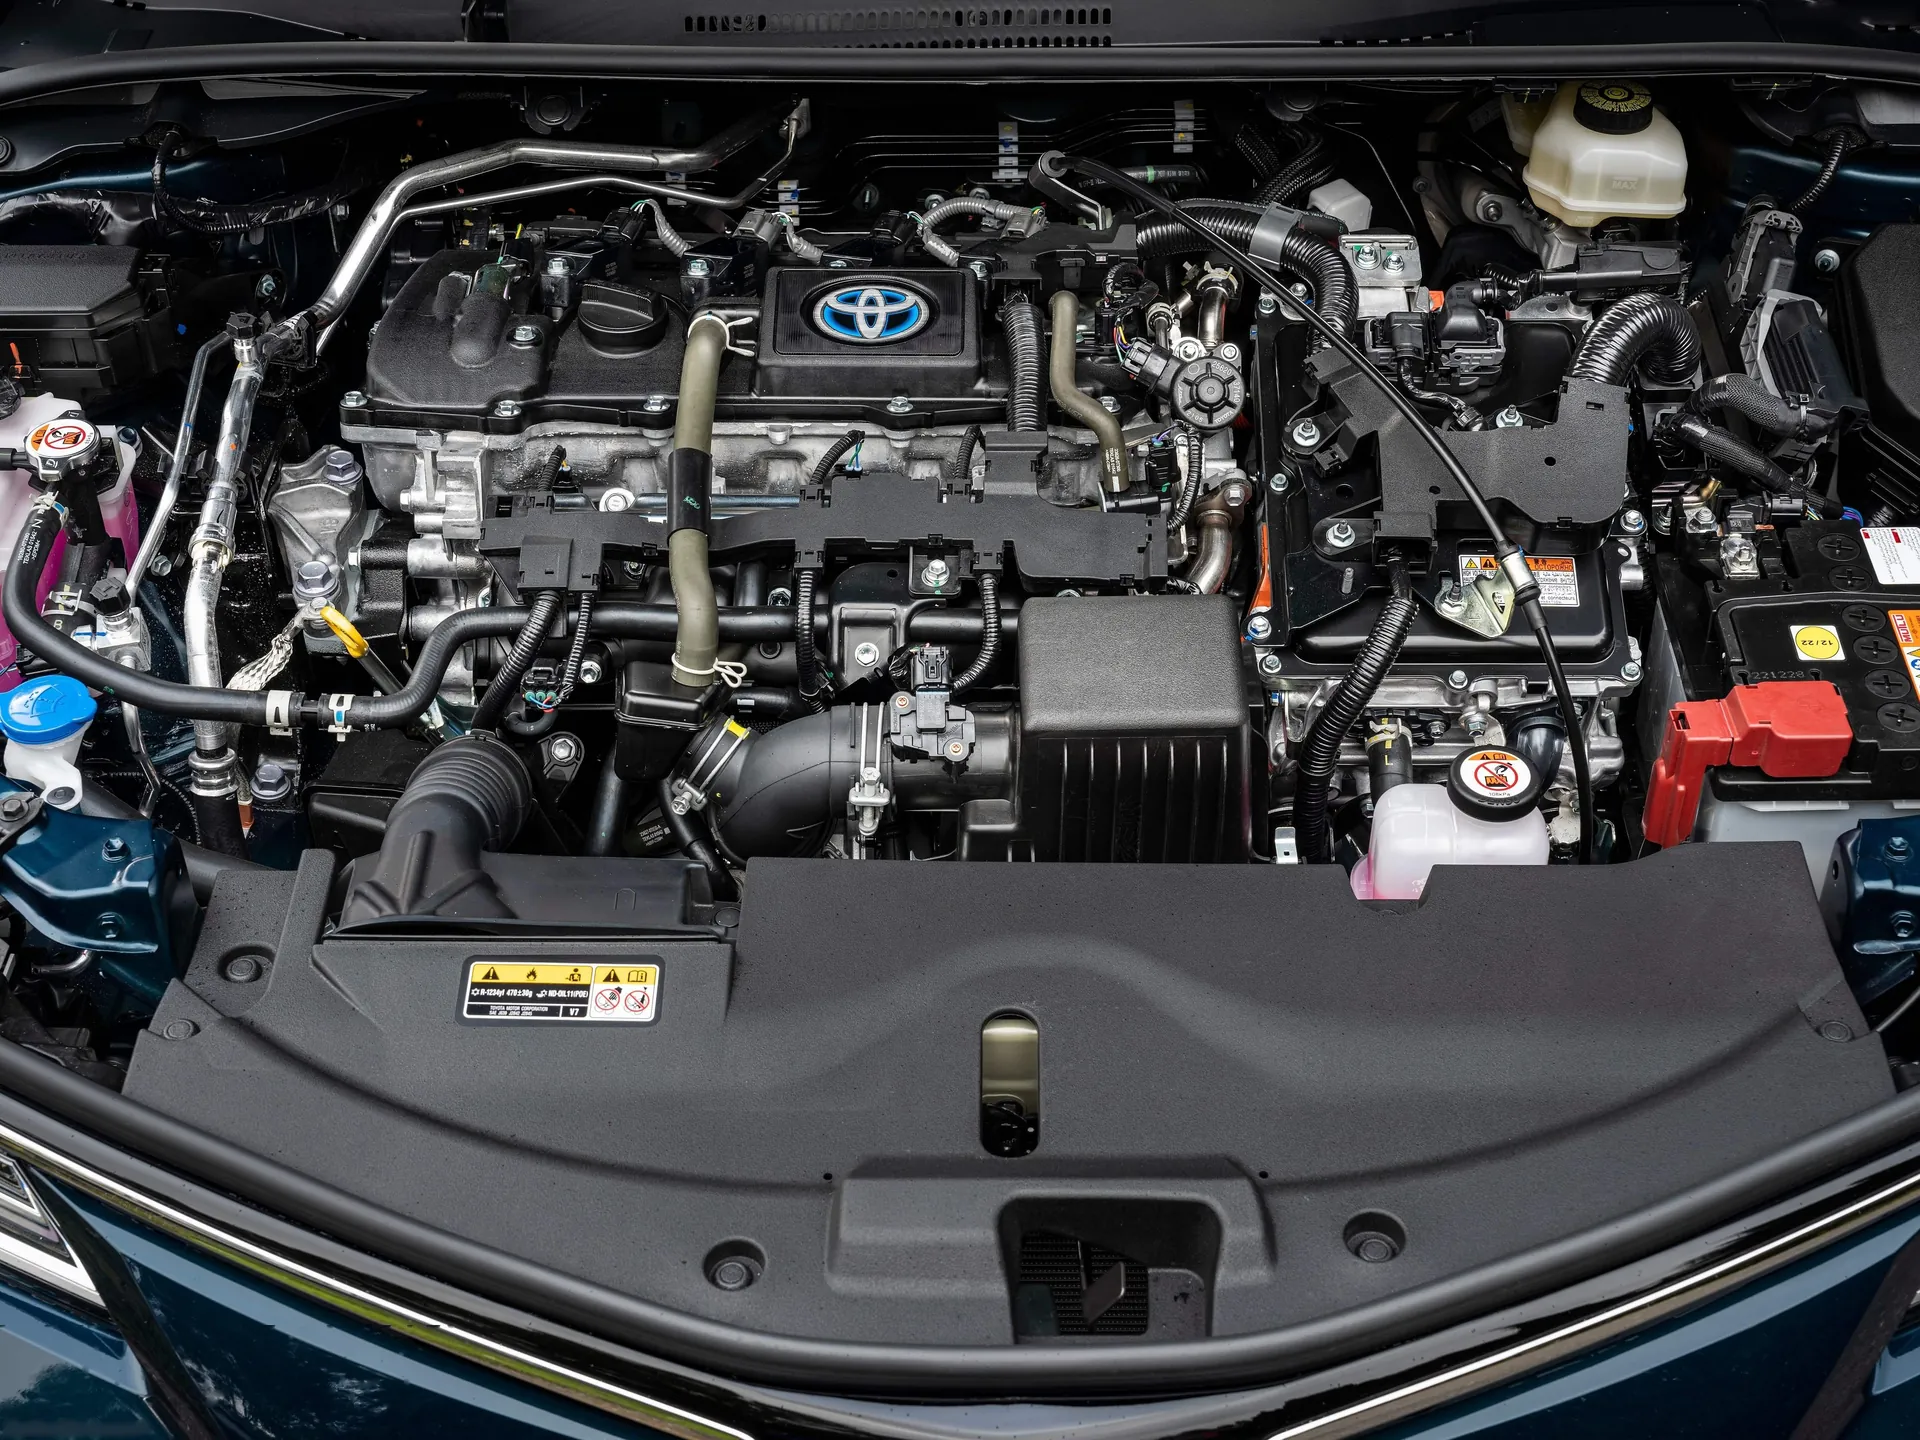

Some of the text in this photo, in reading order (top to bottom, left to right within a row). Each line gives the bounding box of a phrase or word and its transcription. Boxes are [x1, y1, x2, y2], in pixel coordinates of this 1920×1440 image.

[1612, 180, 1637, 190] MAX
[1215, 410, 1234, 424] TOYOTA
[1893, 614, 1913, 643] MUTLU
[1751, 671, 1805, 680] 221228
[569, 1008, 580, 1016] V7
